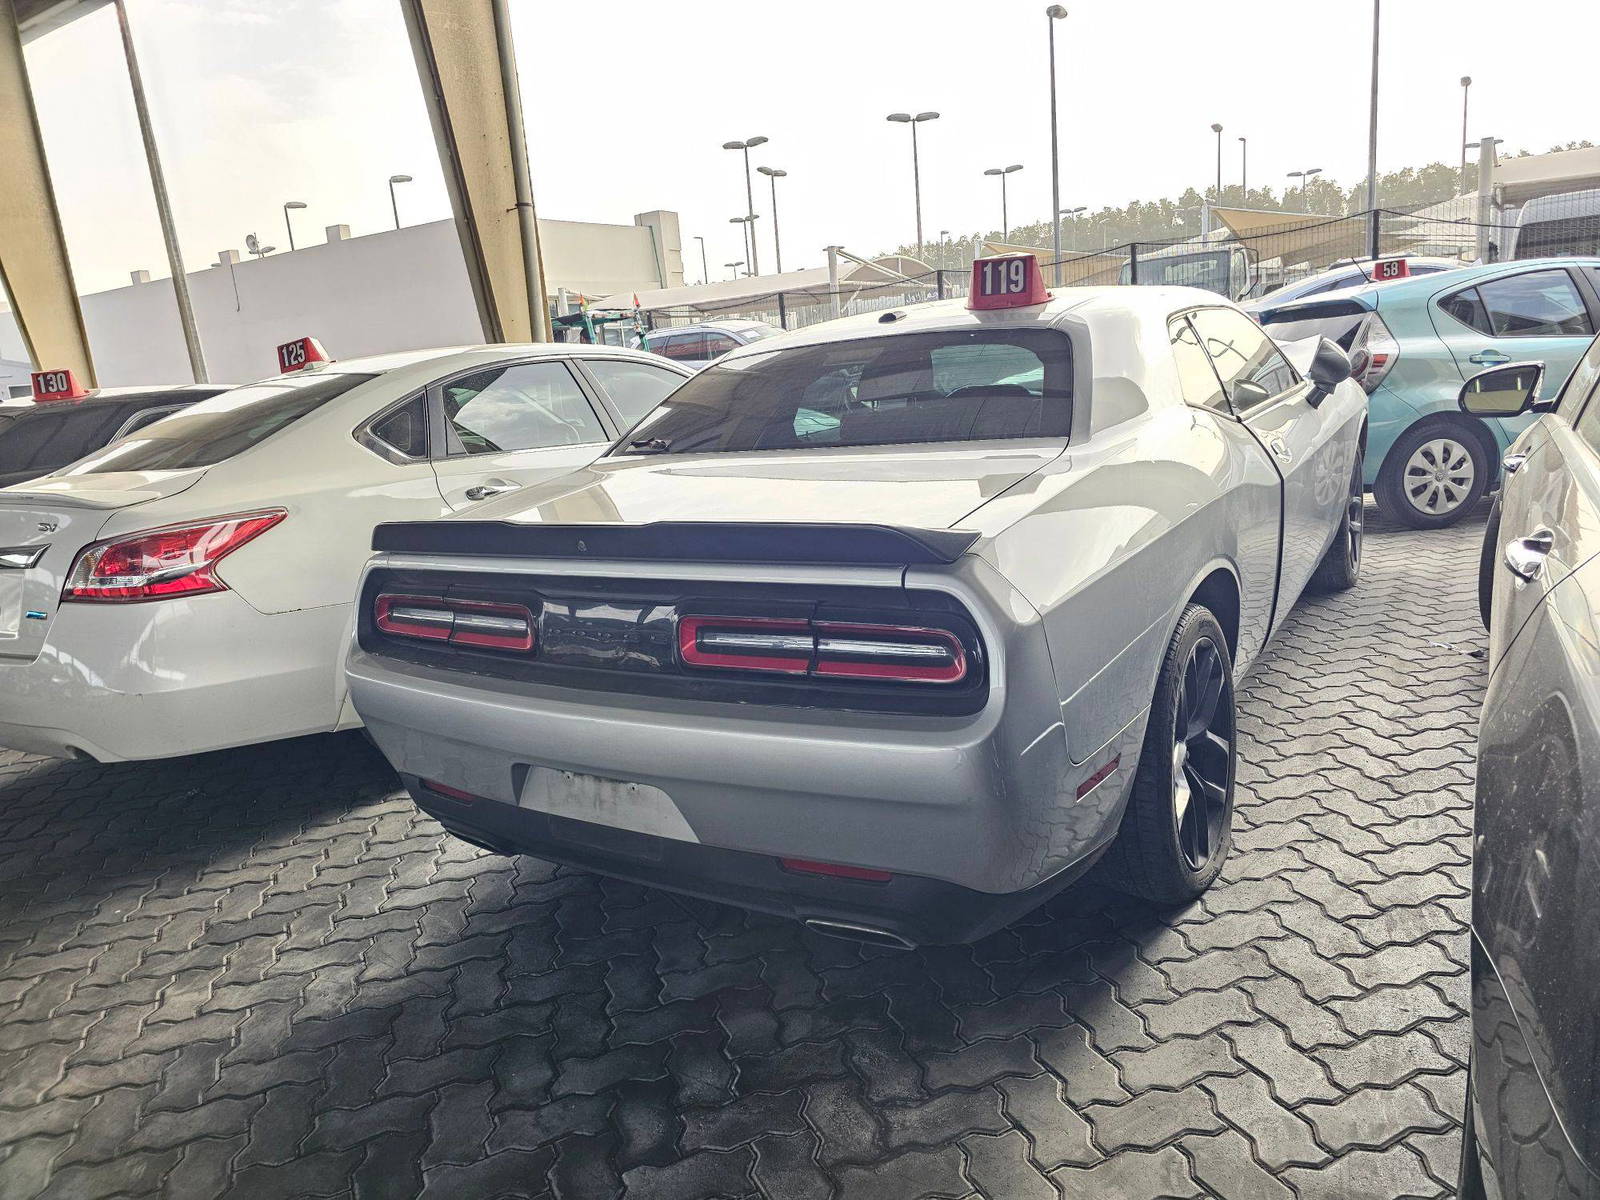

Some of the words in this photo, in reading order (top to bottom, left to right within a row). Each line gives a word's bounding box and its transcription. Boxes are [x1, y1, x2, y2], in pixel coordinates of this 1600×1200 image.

[983, 259, 1024, 295] 119
[1383, 262, 1399, 277] 58
[281, 341, 305, 367] 125
[37, 372, 68, 394] 130
[37, 522, 58, 533] SV
